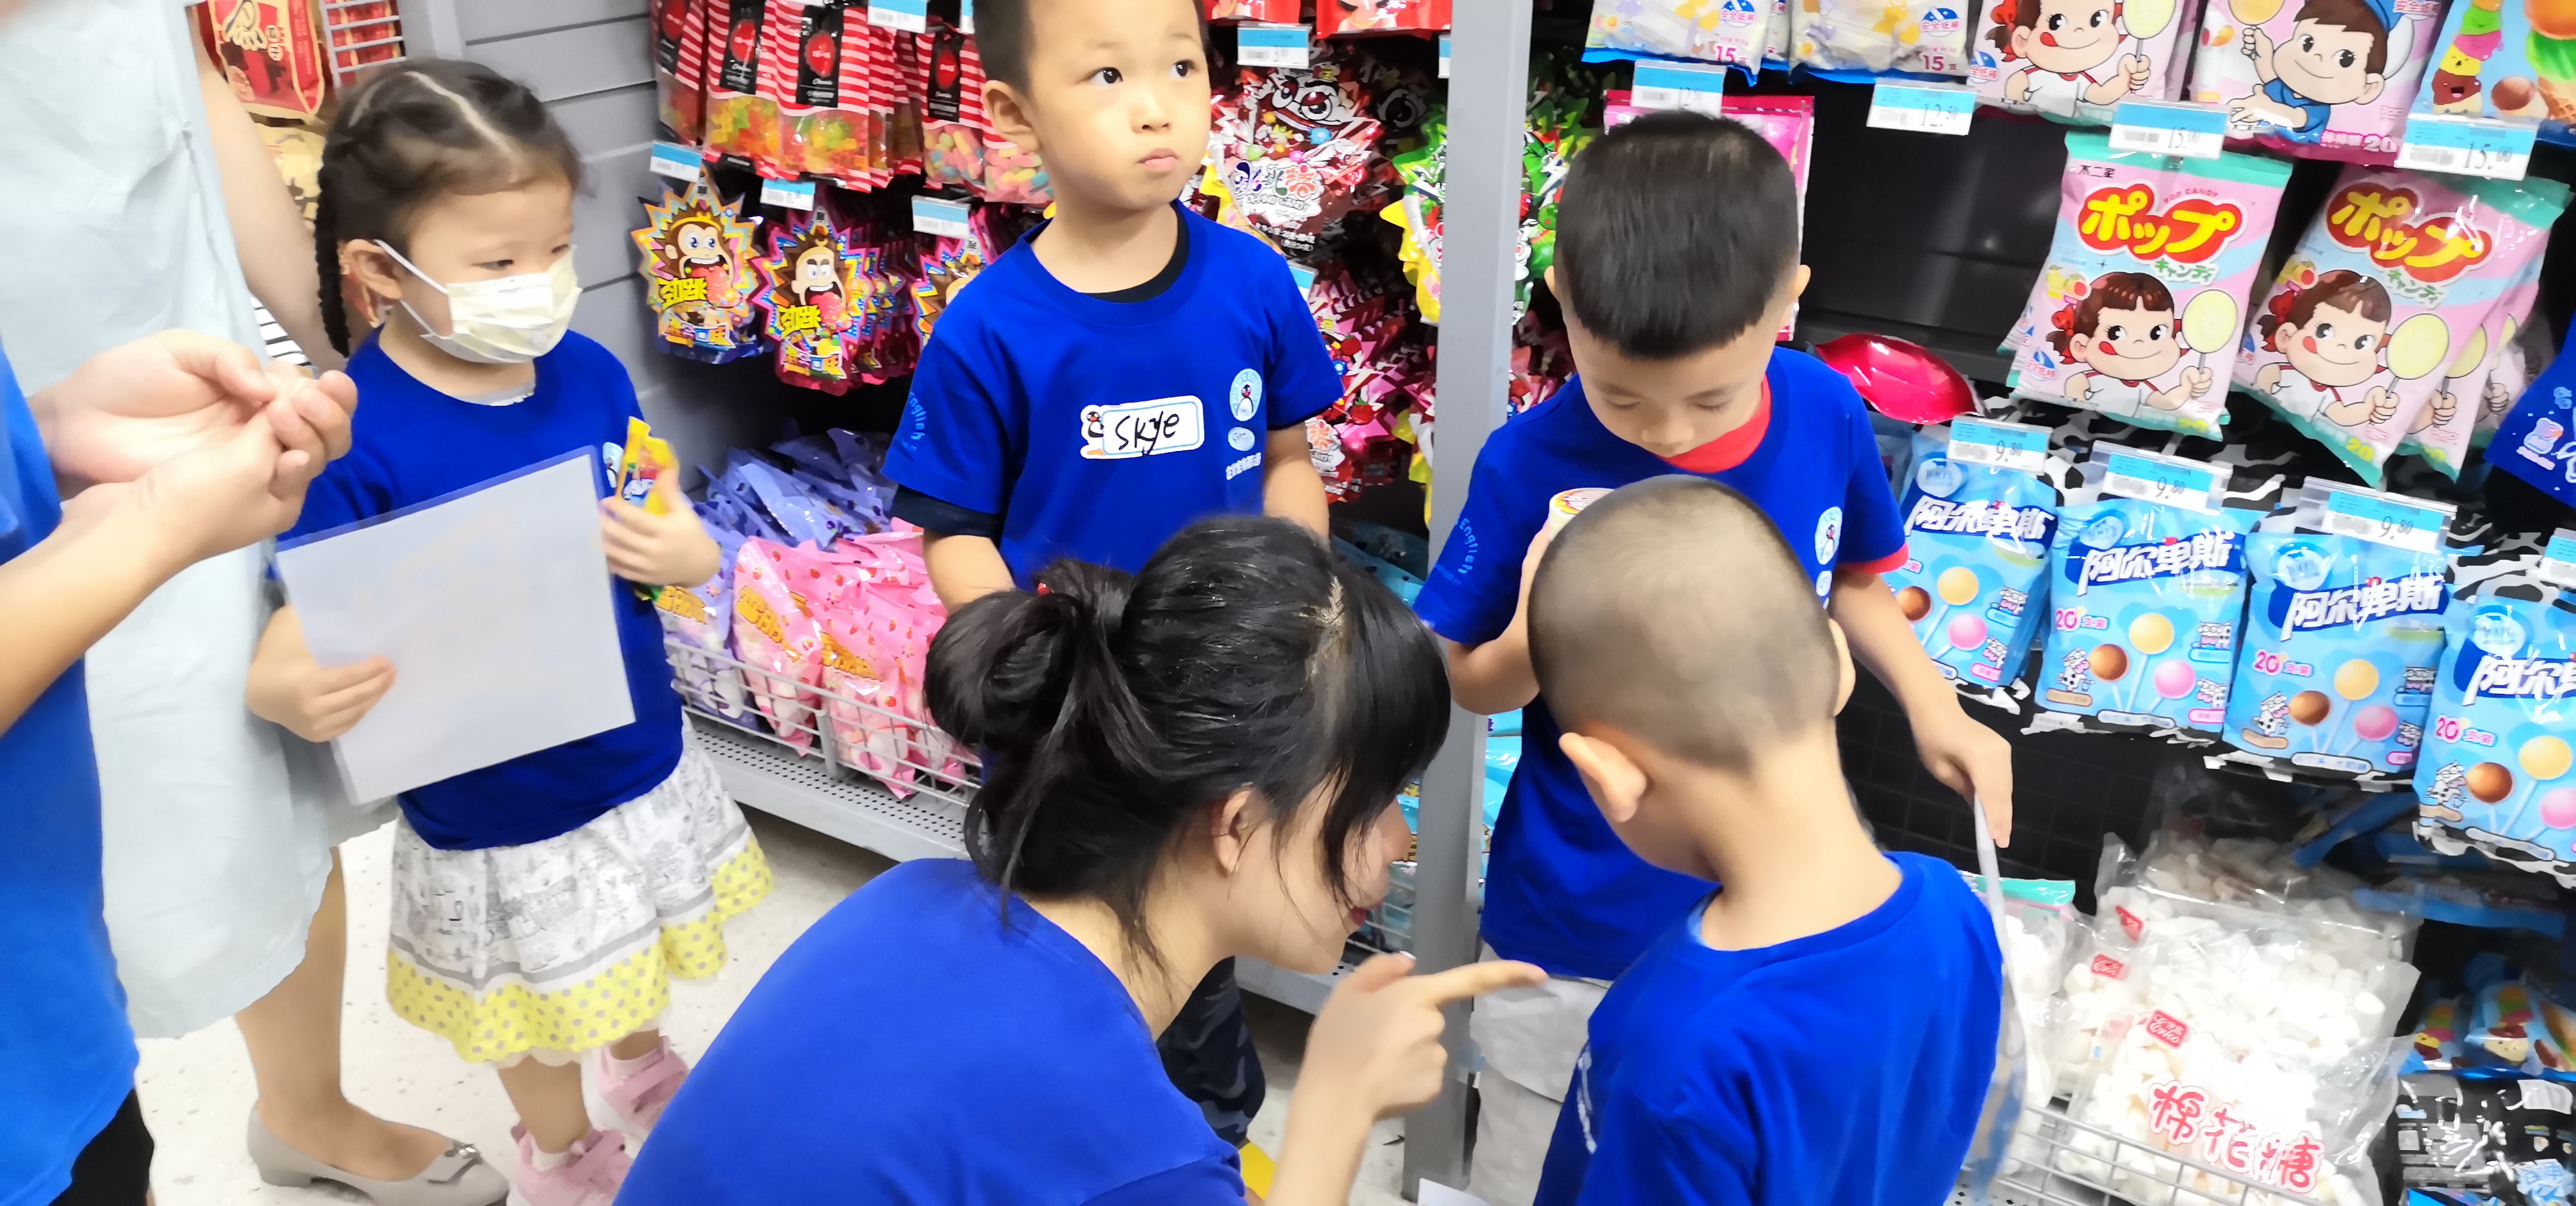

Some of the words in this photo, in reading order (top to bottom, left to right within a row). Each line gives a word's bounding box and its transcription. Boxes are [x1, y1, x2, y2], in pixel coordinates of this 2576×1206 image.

[1923, 55, 1944, 71] 15
[2463, 142, 2514, 170] 15.00
[2081, 189, 2236, 255] ポップ
[2332, 191, 2485, 269] ポップ
[2154, 258, 2217, 283] キャンディ
[2380, 515, 2414, 541] 9.80
[1458, 517, 1479, 574] English
[2077, 526, 2235, 597] 阿尔卑斯
[2280, 562, 2444, 642] 阿尔卑斯
[2056, 609, 2078, 629] 20
[2255, 651, 2280, 674] 20
[2435, 716, 2459, 741] 20
[2152, 1085, 2320, 1189] 棉花糖
